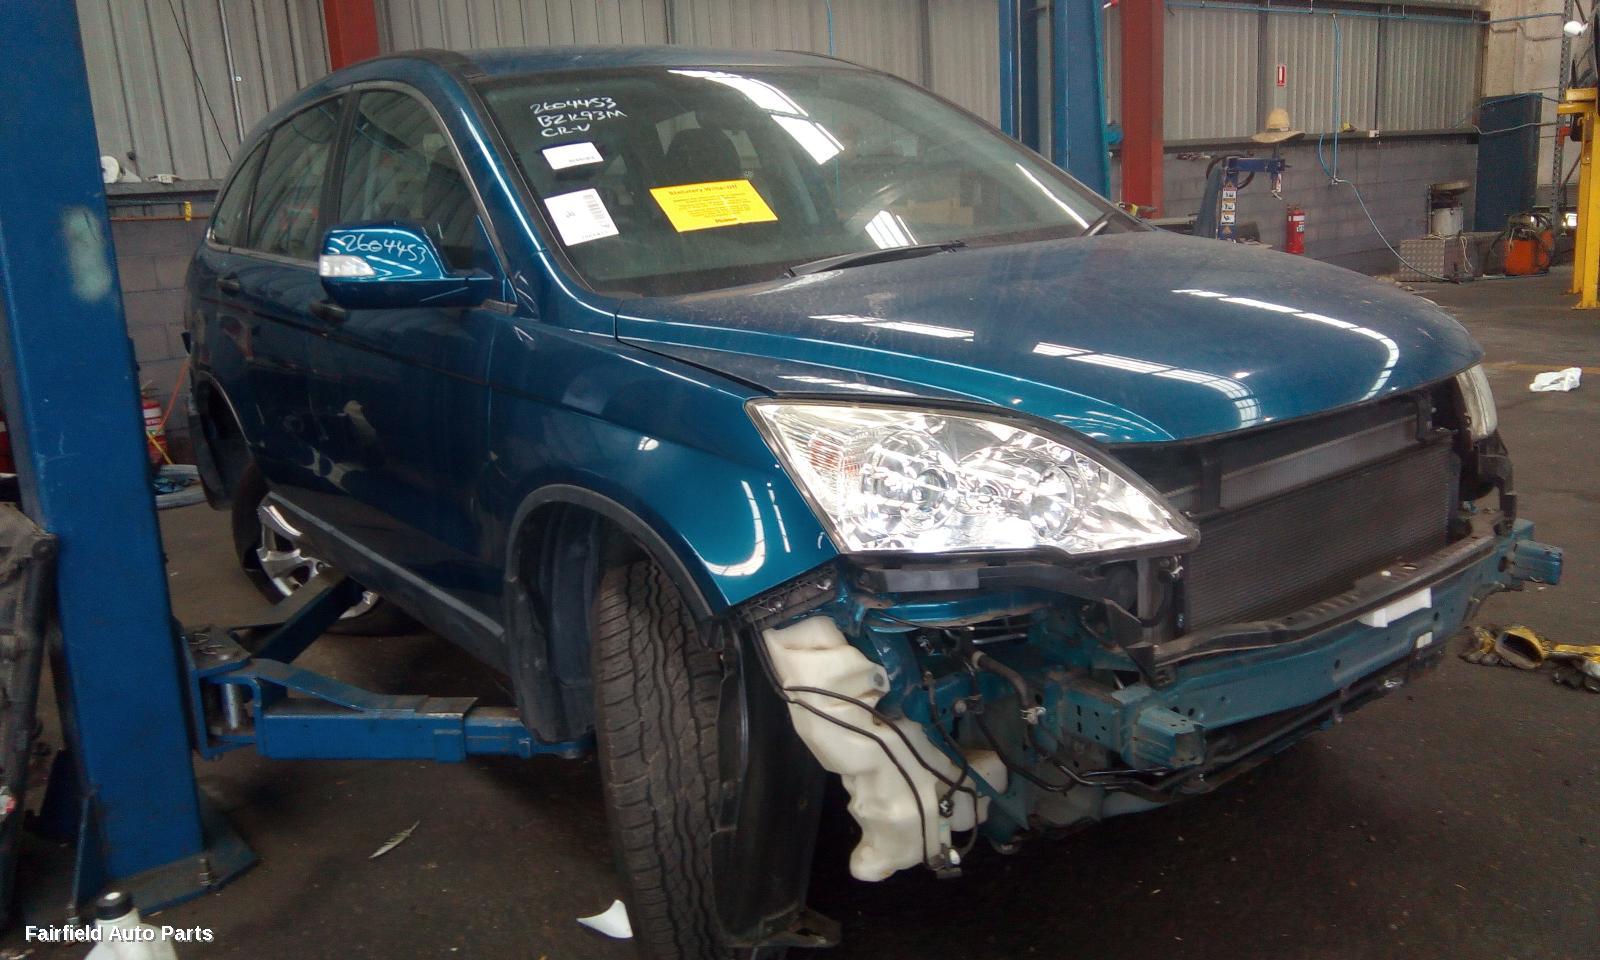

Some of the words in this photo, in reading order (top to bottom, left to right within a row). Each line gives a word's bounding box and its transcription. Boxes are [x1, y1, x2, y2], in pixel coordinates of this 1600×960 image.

[529, 97, 617, 115] 2604453
[536, 109, 628, 128] BZK93M
[340, 233, 427, 265] 2604453
